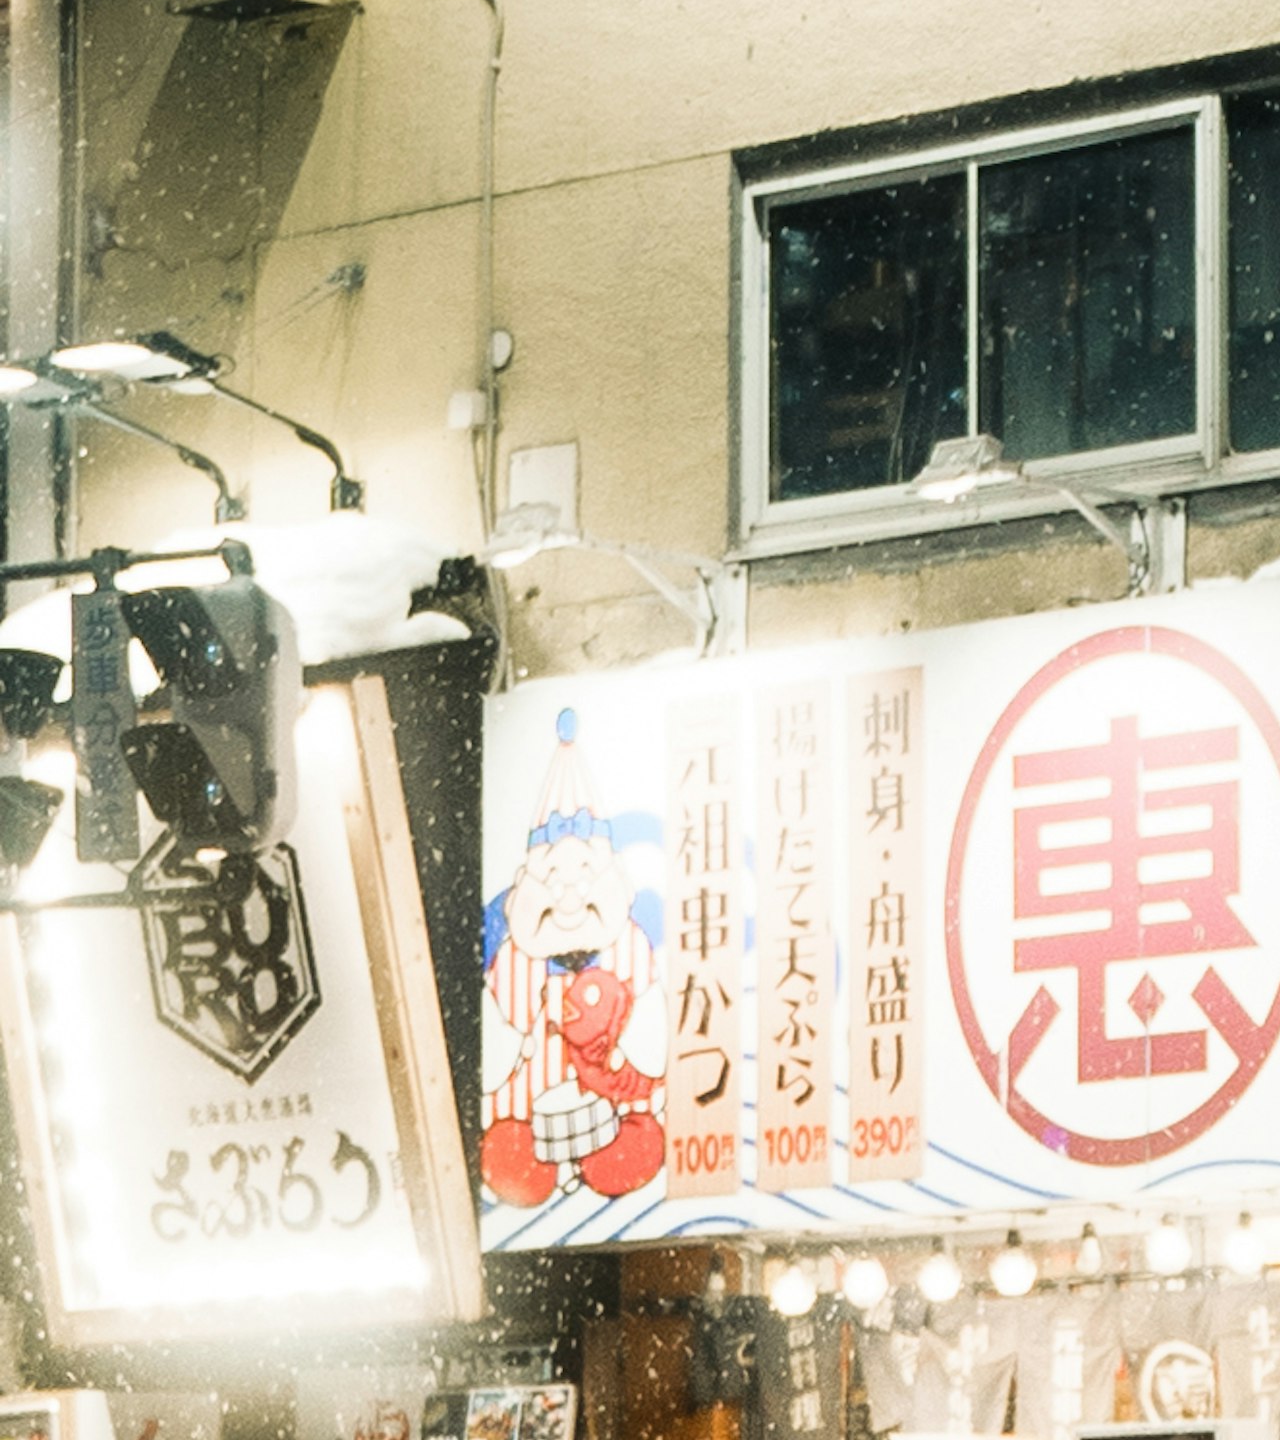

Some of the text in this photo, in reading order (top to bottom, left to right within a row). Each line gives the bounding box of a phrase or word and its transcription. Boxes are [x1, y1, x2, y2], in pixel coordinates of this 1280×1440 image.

[676, 716, 733, 1108] 元祖串かつ
[772, 700, 818, 1107] 揚げたて天ぷら
[862, 689, 911, 1096] 刺身・舟盛り
[150, 1129, 382, 1244] さぶろう
